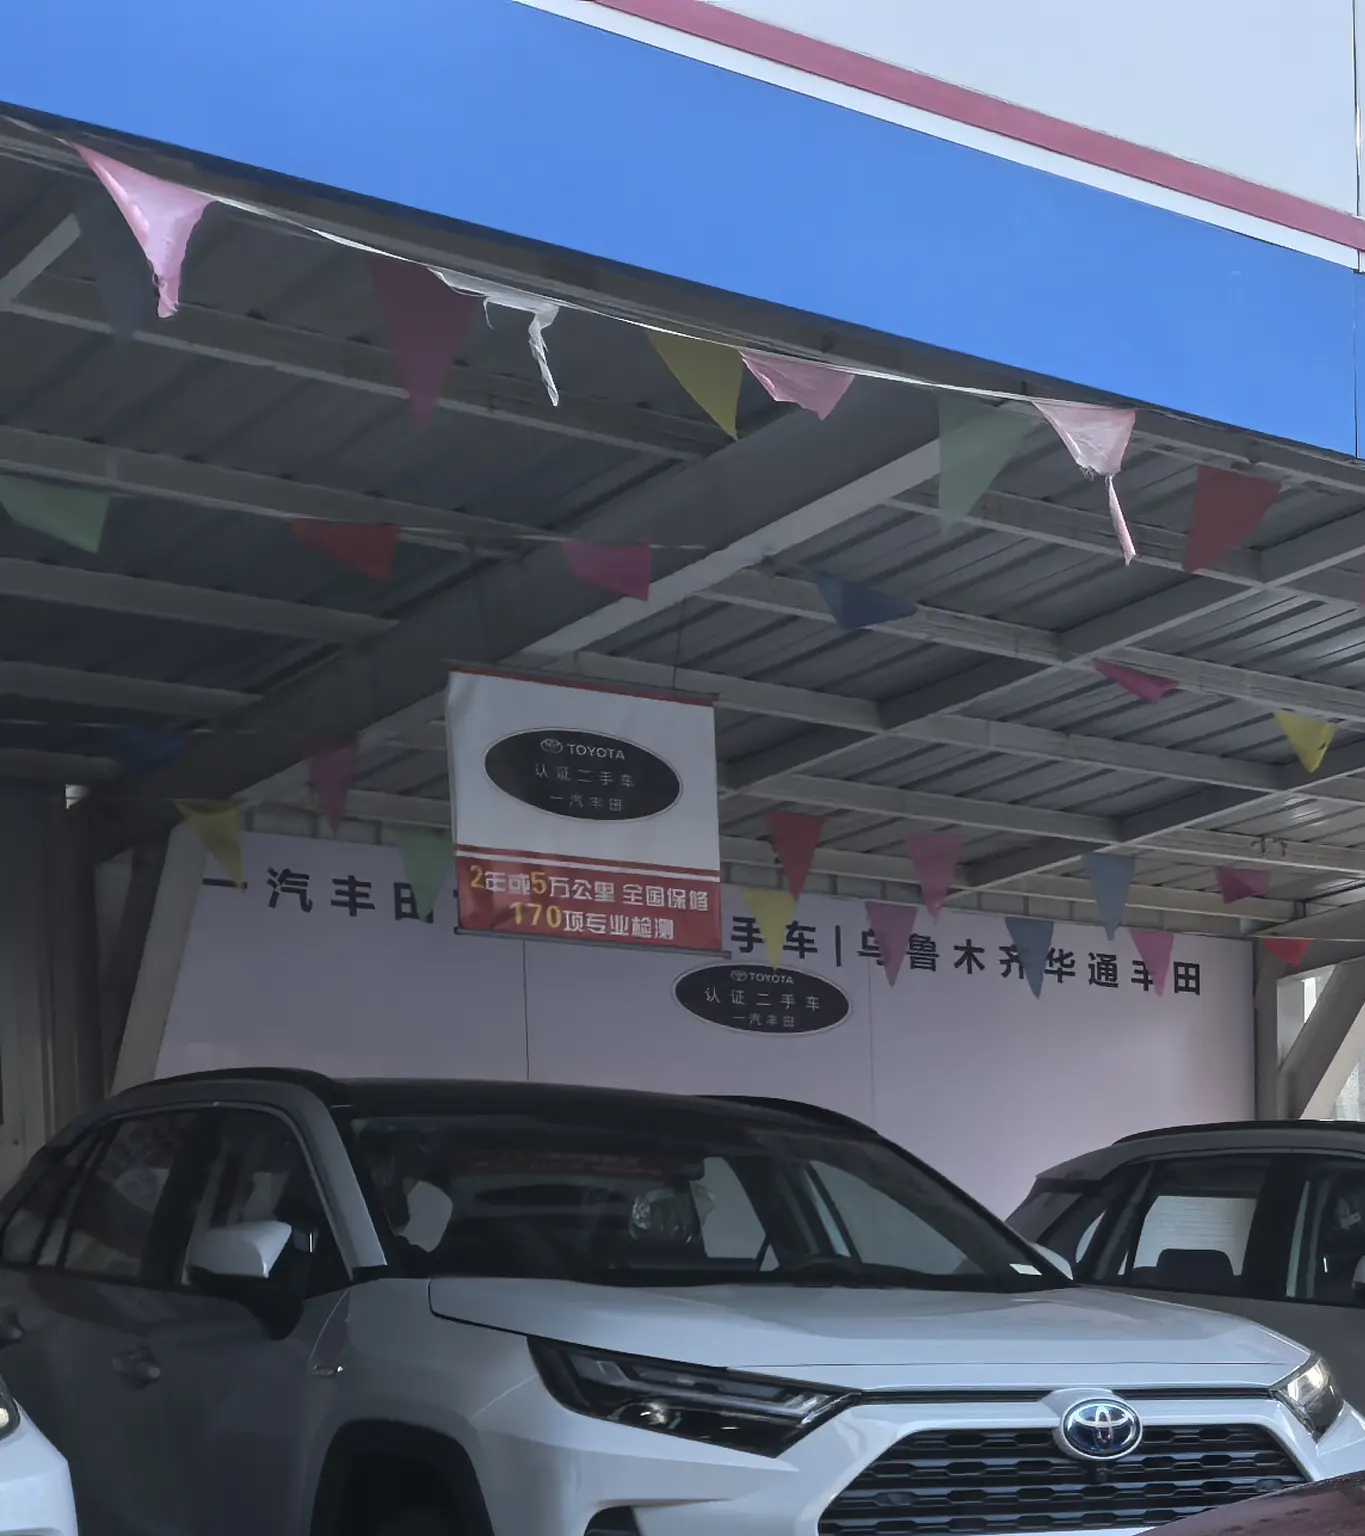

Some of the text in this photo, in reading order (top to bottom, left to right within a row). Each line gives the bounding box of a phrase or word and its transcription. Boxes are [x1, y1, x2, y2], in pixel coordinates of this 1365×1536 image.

[567, 743, 626, 761] TOYOTA
[534, 763, 636, 788] 认证二手车
[469, 864, 616, 904] 2年或5万公里
[508, 901, 675, 941] 170项专业检测
[750, 972, 795, 985] TOYOTA
[704, 987, 820, 1012] 认证二手车
